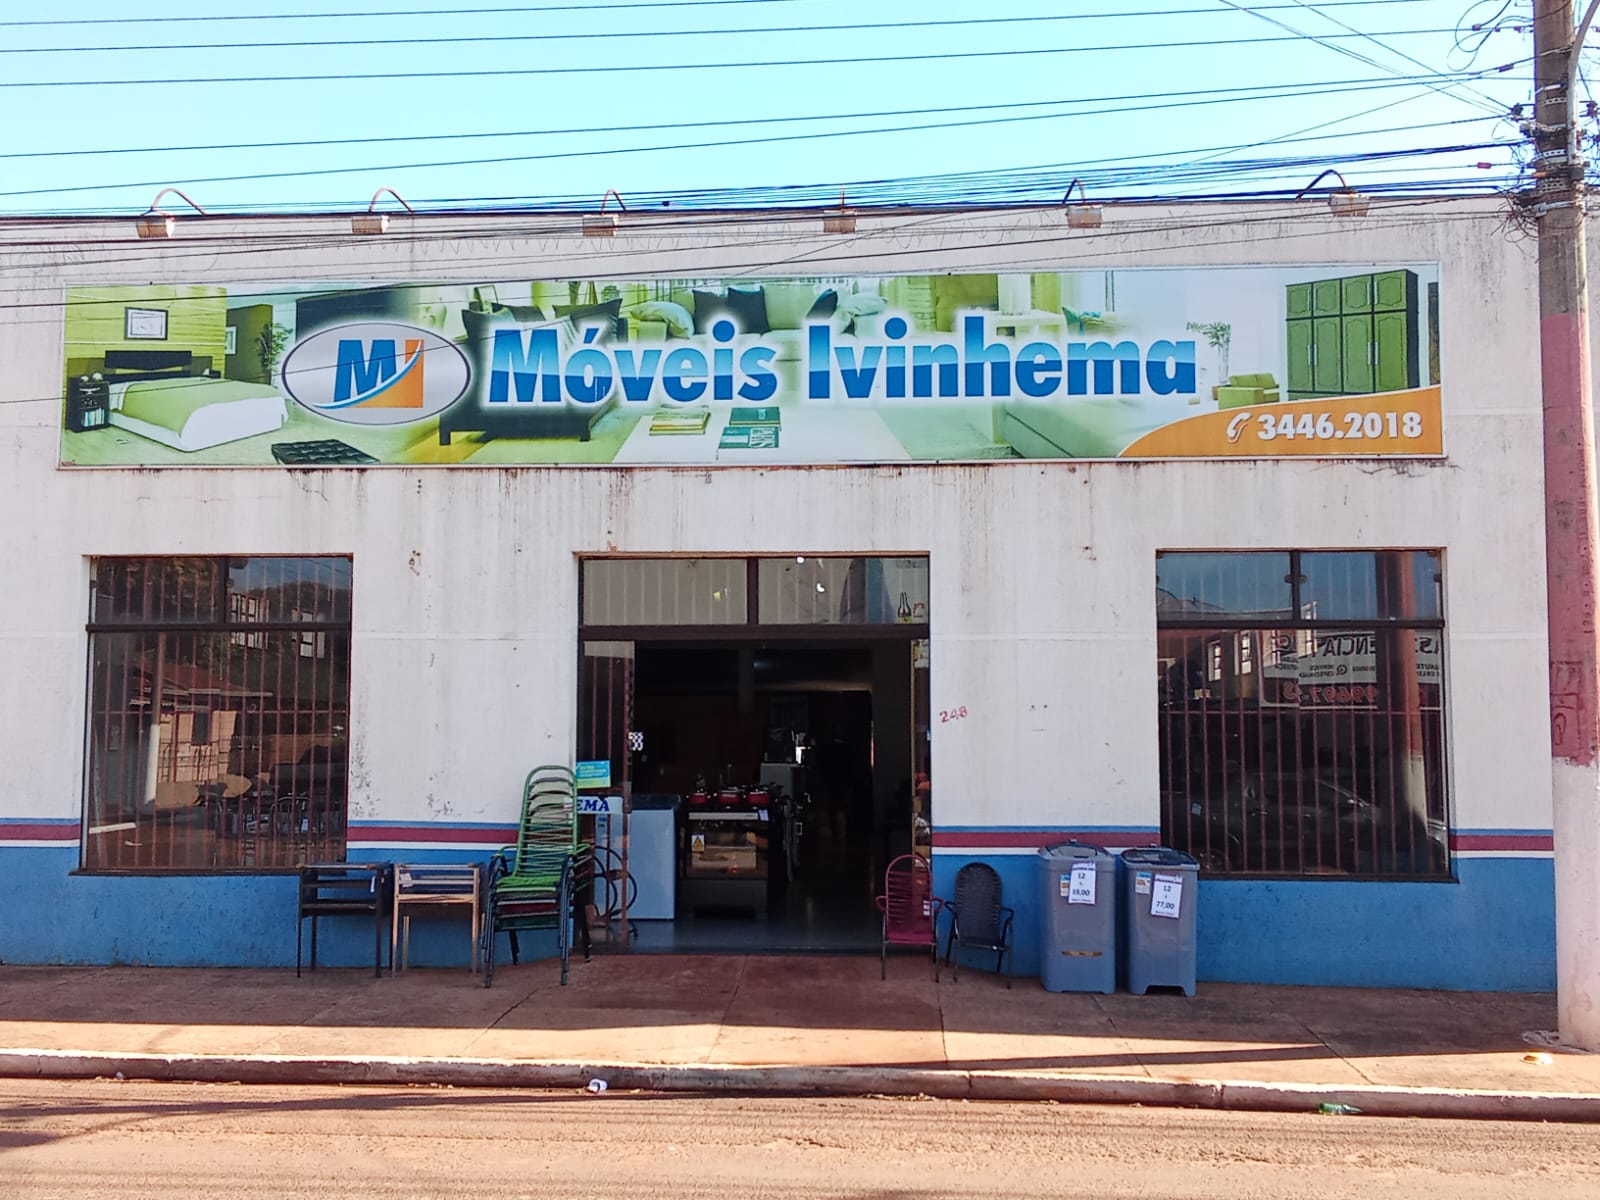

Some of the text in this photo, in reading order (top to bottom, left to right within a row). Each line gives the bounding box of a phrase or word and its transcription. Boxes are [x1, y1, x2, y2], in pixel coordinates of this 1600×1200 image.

[489, 319, 778, 404] Móveis
[808, 316, 1196, 399] Ivinhema
[1257, 412, 1423, 440] 3446.2018
